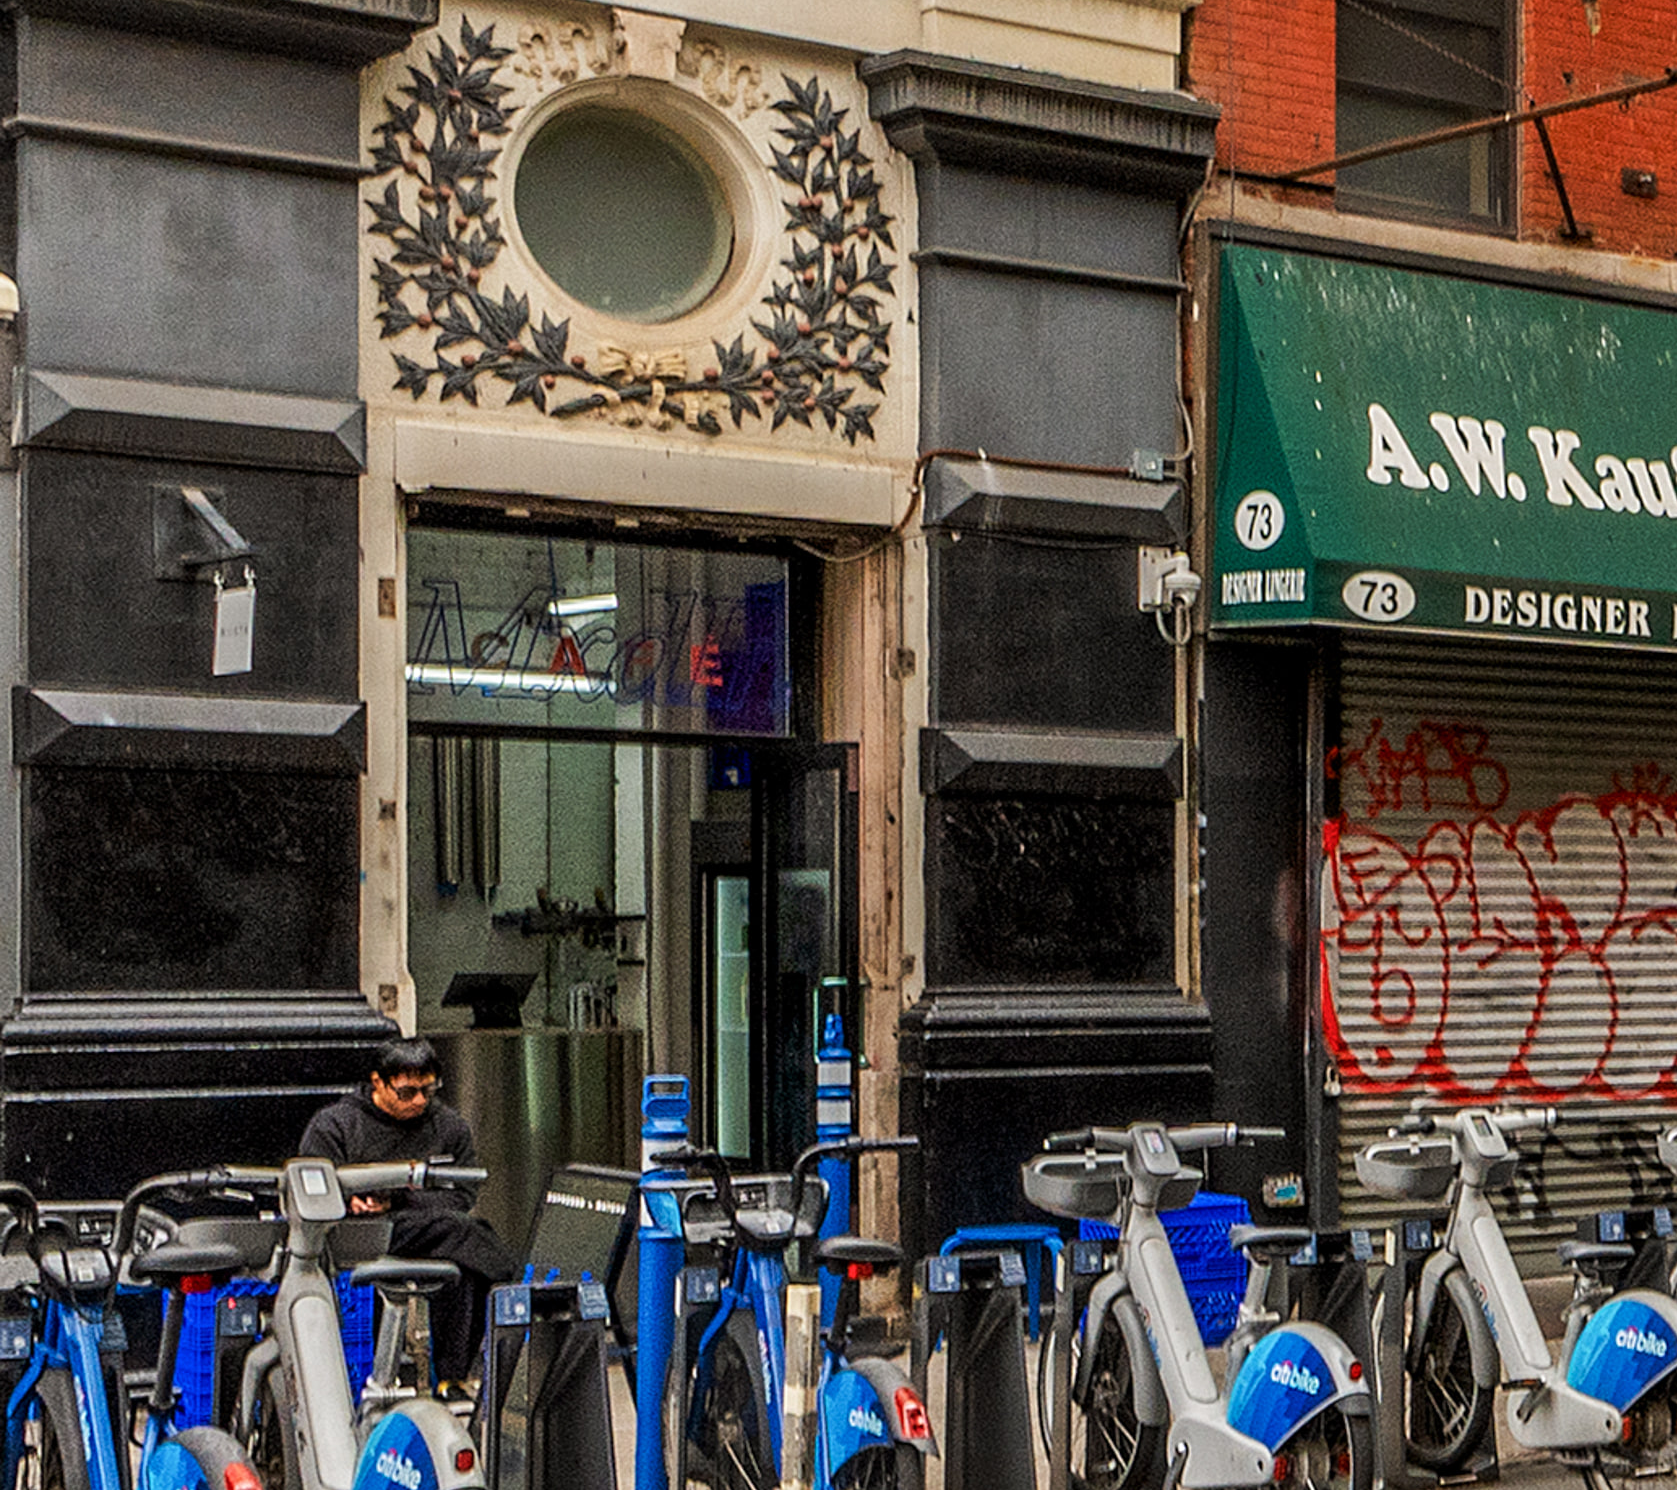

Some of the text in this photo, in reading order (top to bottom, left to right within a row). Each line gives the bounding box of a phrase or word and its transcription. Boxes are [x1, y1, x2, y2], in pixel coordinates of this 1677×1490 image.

[1366, 403, 1527, 502] A.W.
[1247, 503, 1272, 541] 73
[1359, 580, 1398, 615] 73
[1464, 585, 1651, 638] DESIGNER
